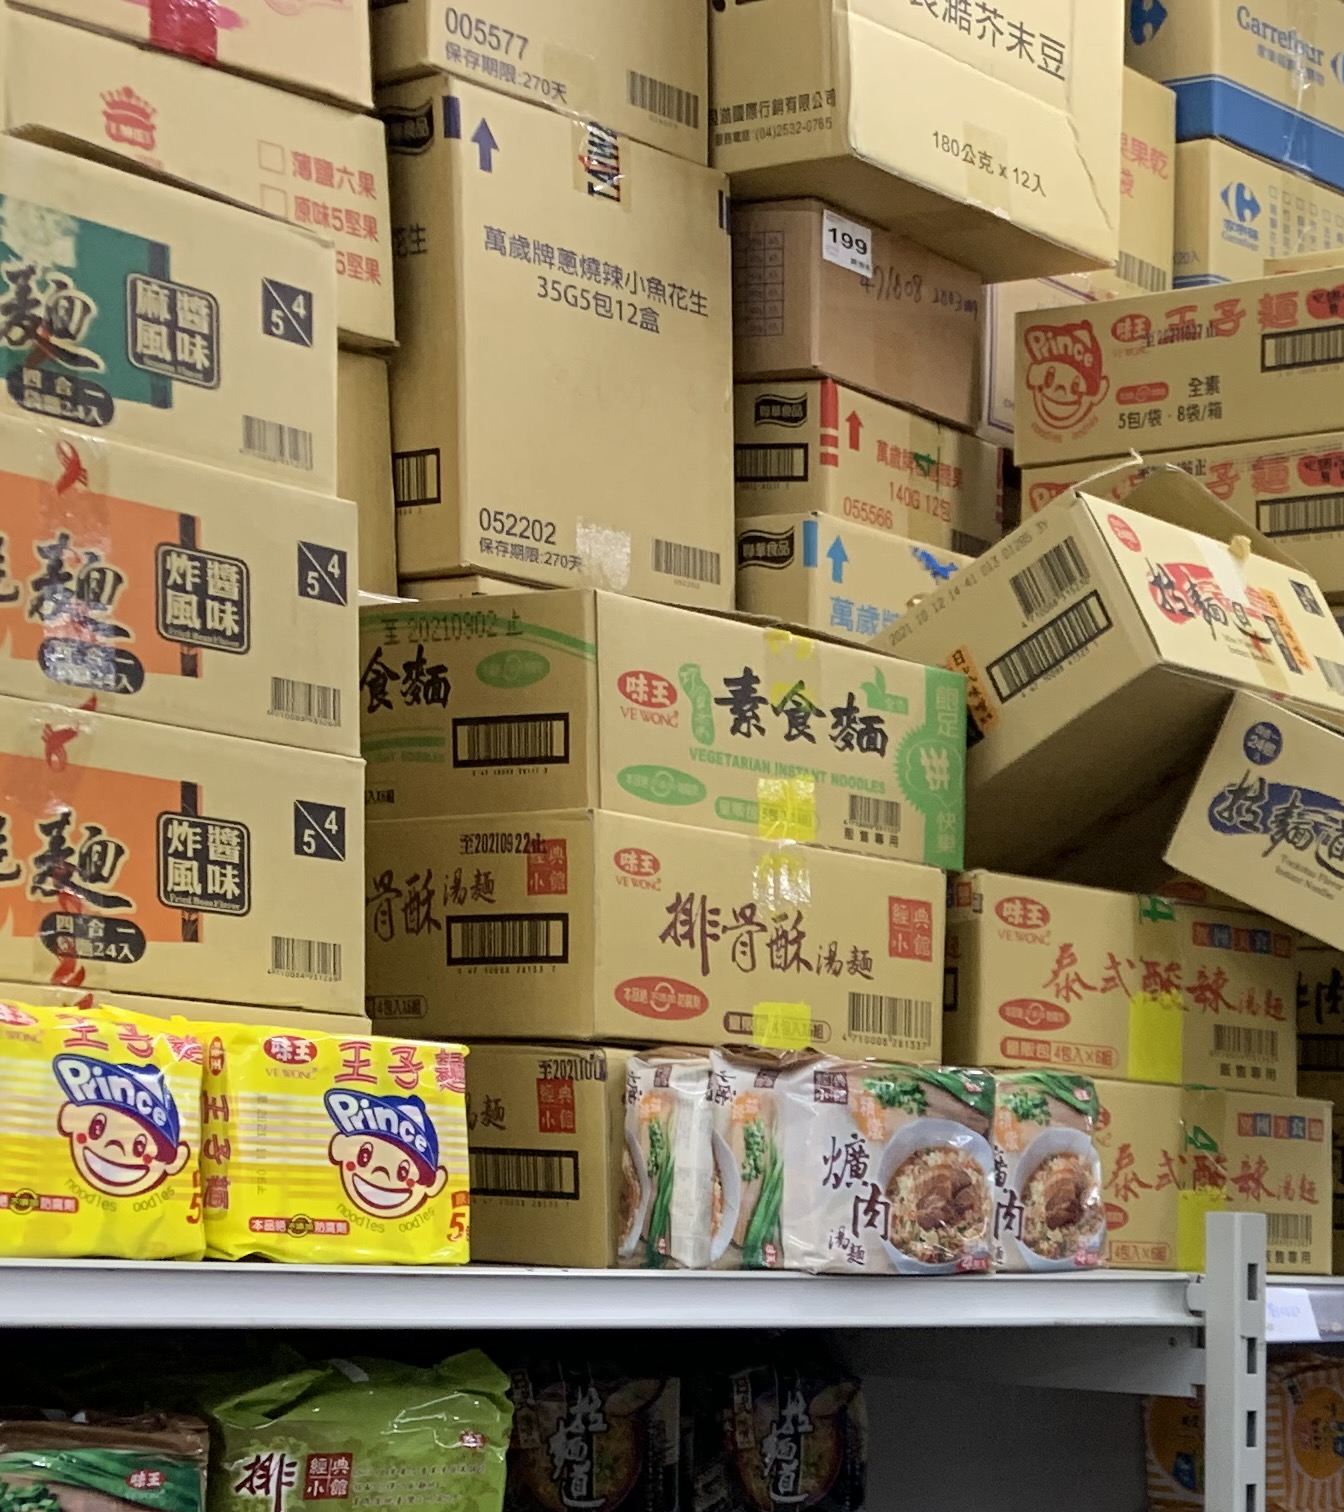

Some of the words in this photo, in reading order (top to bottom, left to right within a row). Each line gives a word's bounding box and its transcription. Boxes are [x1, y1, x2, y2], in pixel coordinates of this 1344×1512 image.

[445, 8, 530, 60] 005577
[1236, 5, 1326, 68] Carrefour
[444, 41, 568, 105] 保存期限:270天
[932, 131, 995, 176] 180公克
[1012, 167, 1048, 199] 12入
[294, 196, 380, 242] 原味5堅果
[828, 227, 869, 256] 199
[136, 282, 210, 336] 麻醬
[292, 295, 307, 318] 4
[537, 275, 661, 335] 35G5包12盒
[1164, 291, 1300, 338] 王子麵
[270, 310, 285, 336] 5
[136, 318, 211, 371] 風味
[1029, 328, 1096, 370] Prince
[1187, 375, 1221, 398] 全素
[478, 508, 557, 546] 052202
[843, 497, 893, 529] 055566
[166, 551, 240, 601] 炸醬
[306, 571, 320, 597] 5
[327, 554, 341, 579] 4
[166, 590, 240, 637] 風味
[625, 672, 672, 706] 味王
[620, 705, 639, 720] VE
[640, 707, 676, 729] WONG
[714, 666, 889, 759] 素食麵
[689, 747, 772, 778] VEGETARIAN
[773, 761, 828, 786] INSTANT
[829, 769, 887, 796] NOODLES
[324, 810, 338, 835] 4
[29, 808, 134, 911] 麵
[167, 819, 241, 865] 炸醬
[303, 829, 317, 855] 5
[459, 831, 548, 855] 至20210922止
[168, 856, 242, 901] 風味
[620, 851, 657, 876] 味王
[615, 875, 630, 888] VE
[631, 876, 659, 892] WONG
[892, 903, 931, 930] 經典
[1001, 900, 1046, 926] 味王
[659, 891, 875, 981] 排骨酥湯麵
[892, 932, 932, 958] 小館
[1043, 942, 1287, 1022] 泰式酸辣湯麵
[269, 1038, 313, 1062] 味王
[335, 1041, 467, 1093] 王子麵
[282, 1066, 316, 1081] WONG
[56, 1057, 169, 1128] Prince
[326, 1092, 430, 1155] Prince
[1104, 1142, 1321, 1206] 泰式酸辣湯麵
[66, 1178, 118, 1213] noodles
[132, 1187, 176, 1214] oodles
[336, 1204, 386, 1234] noodles
[397, 1208, 436, 1235] oodles
[308, 1456, 351, 1476] 經典
[306, 1479, 349, 1497] 小館
